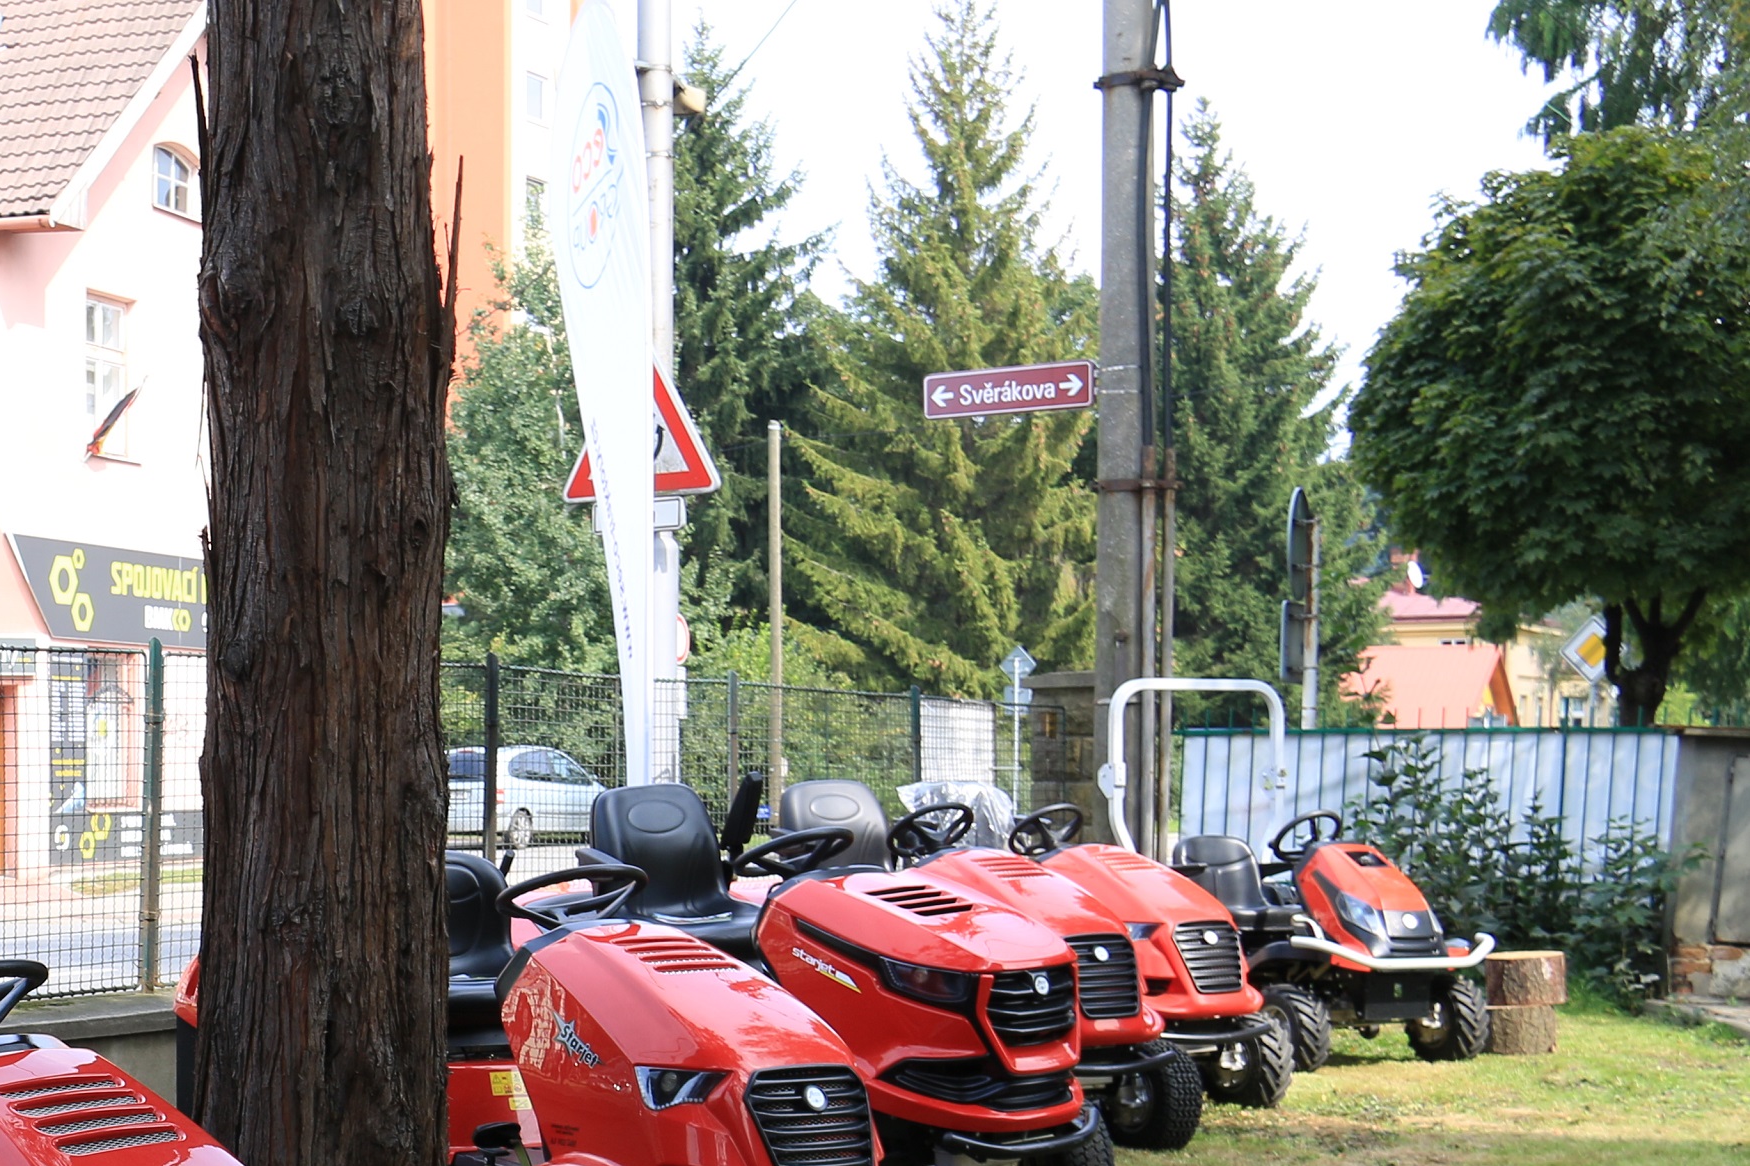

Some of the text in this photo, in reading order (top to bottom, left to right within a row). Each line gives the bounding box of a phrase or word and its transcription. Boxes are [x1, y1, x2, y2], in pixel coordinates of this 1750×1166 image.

[959, 380, 1056, 406] Svěrákova
[110, 561, 199, 604] SPOJOVACÍ
[791, 947, 837, 976] starjet
[560, 1025, 598, 1068] Starjet
